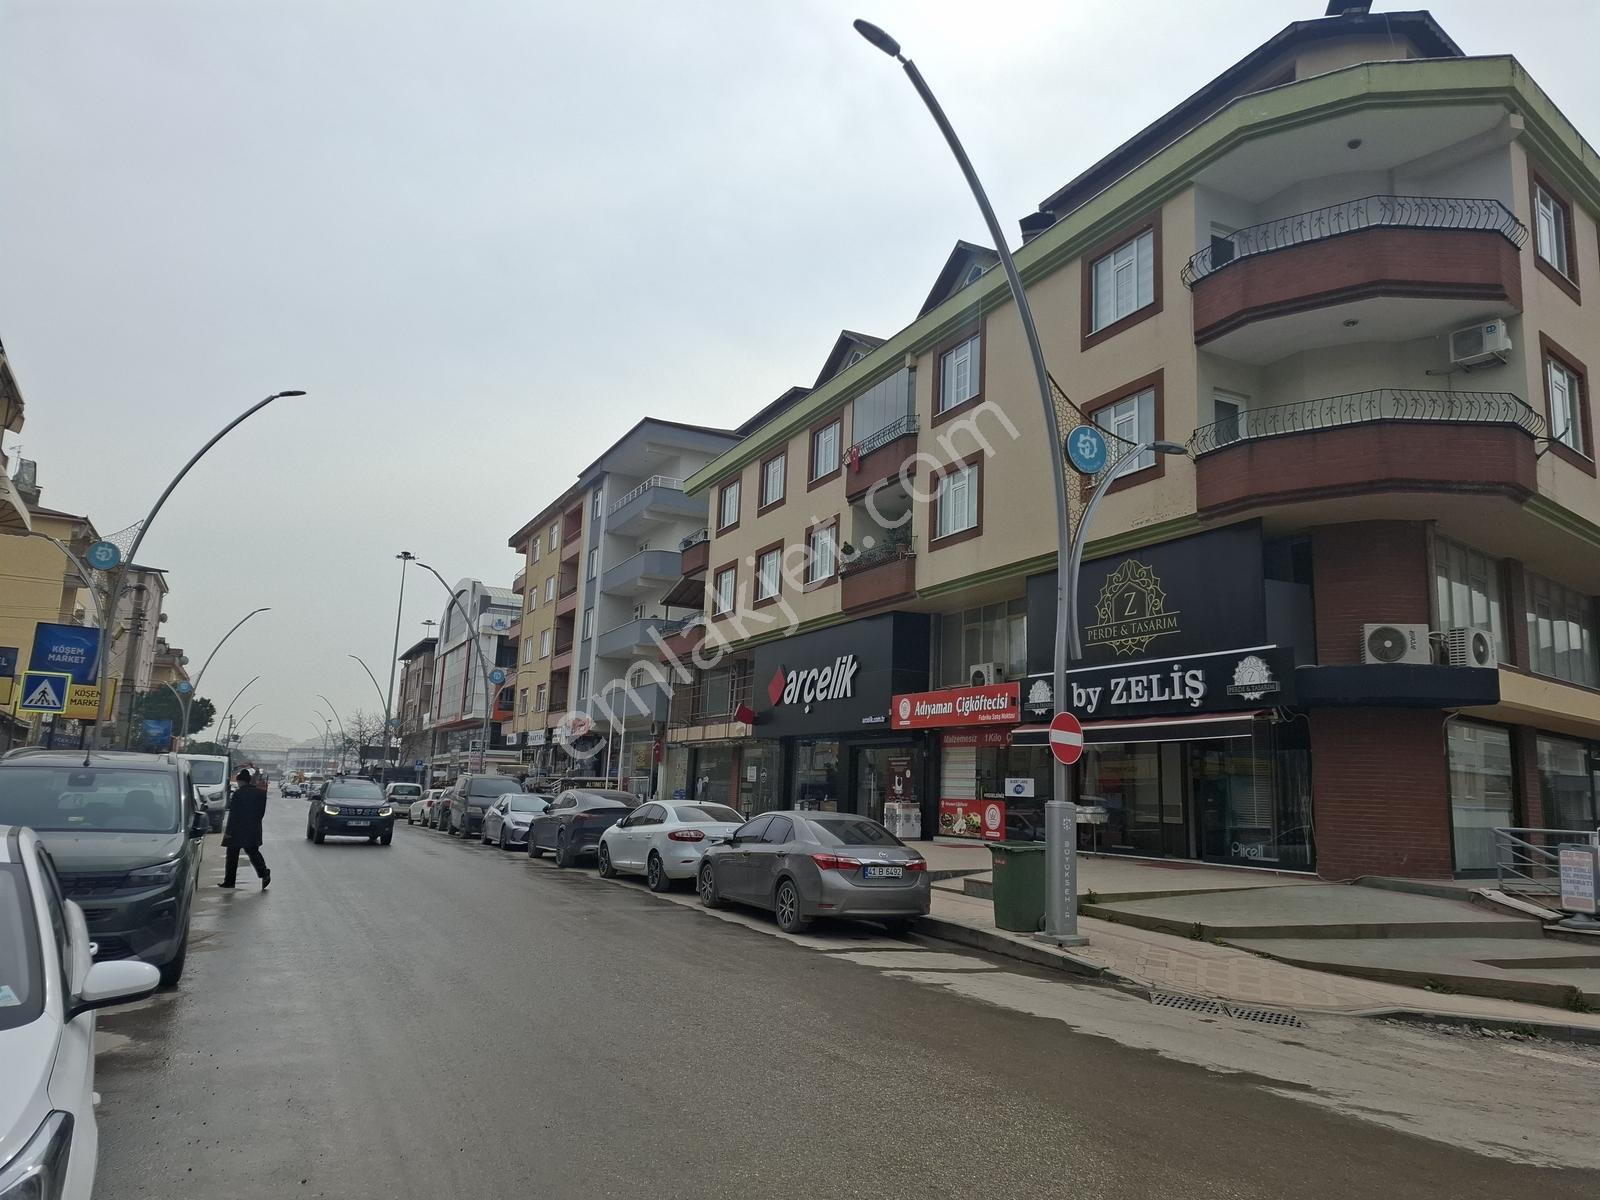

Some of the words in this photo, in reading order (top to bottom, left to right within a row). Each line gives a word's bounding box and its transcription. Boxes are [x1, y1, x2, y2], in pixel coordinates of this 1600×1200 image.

[1124, 592, 1137, 616] Z
[1087, 626, 1118, 641] PERDE
[1120, 624, 1128, 636] &
[1130, 616, 1178, 635] TASARIM
[48, 653, 86, 664] MARKET
[783, 654, 858, 714] arçelik
[1071, 682, 1102, 713] by
[1110, 664, 1207, 707] ZELİŞ
[70, 698, 100, 708] MARKE
[914, 700, 953, 719] Adıyaman
[955, 692, 1008, 717] Çiğköftecisi
[868, 867, 876, 876] 41
[878, 867, 884, 876] B
[885, 867, 902, 876] 6492
